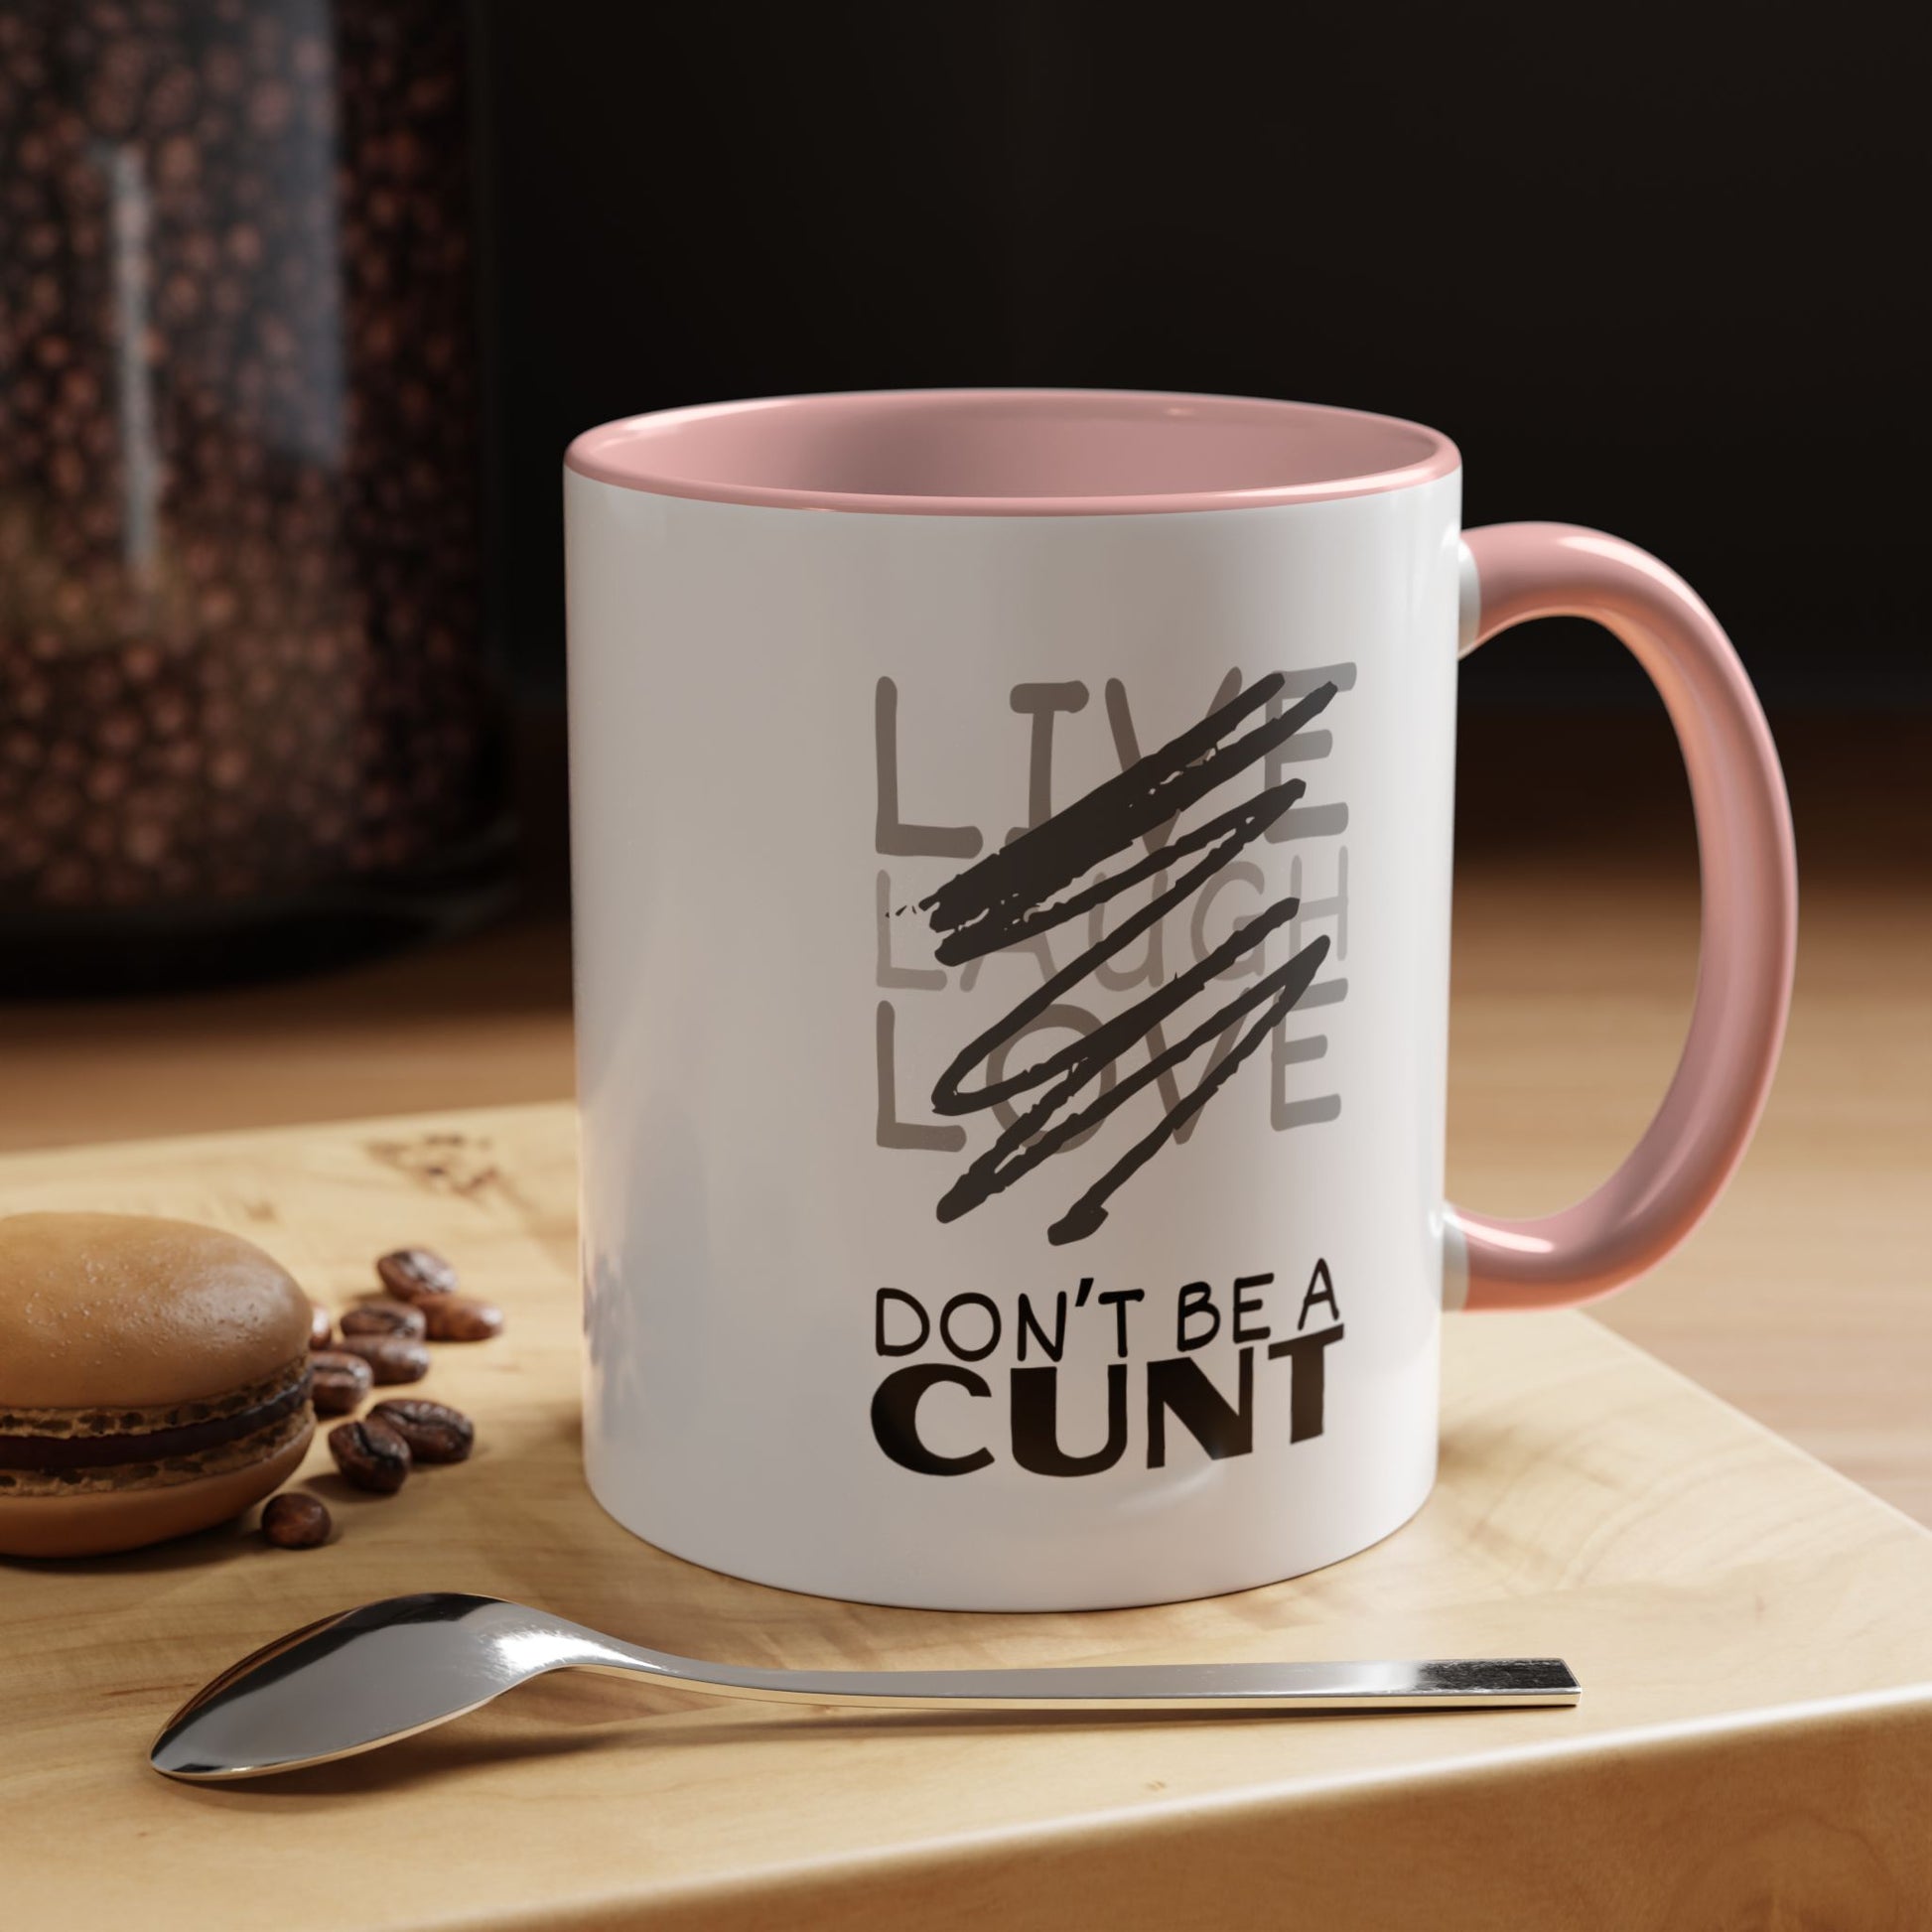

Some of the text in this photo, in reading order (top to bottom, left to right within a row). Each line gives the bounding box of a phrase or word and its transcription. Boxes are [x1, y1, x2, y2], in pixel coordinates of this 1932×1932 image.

[876, 661, 1357, 860] LIVE
[876, 978, 1348, 1154] LOVE
[876, 1258, 1339, 1362] DON'T BE A
[870, 1323, 1344, 1477] CUNT
